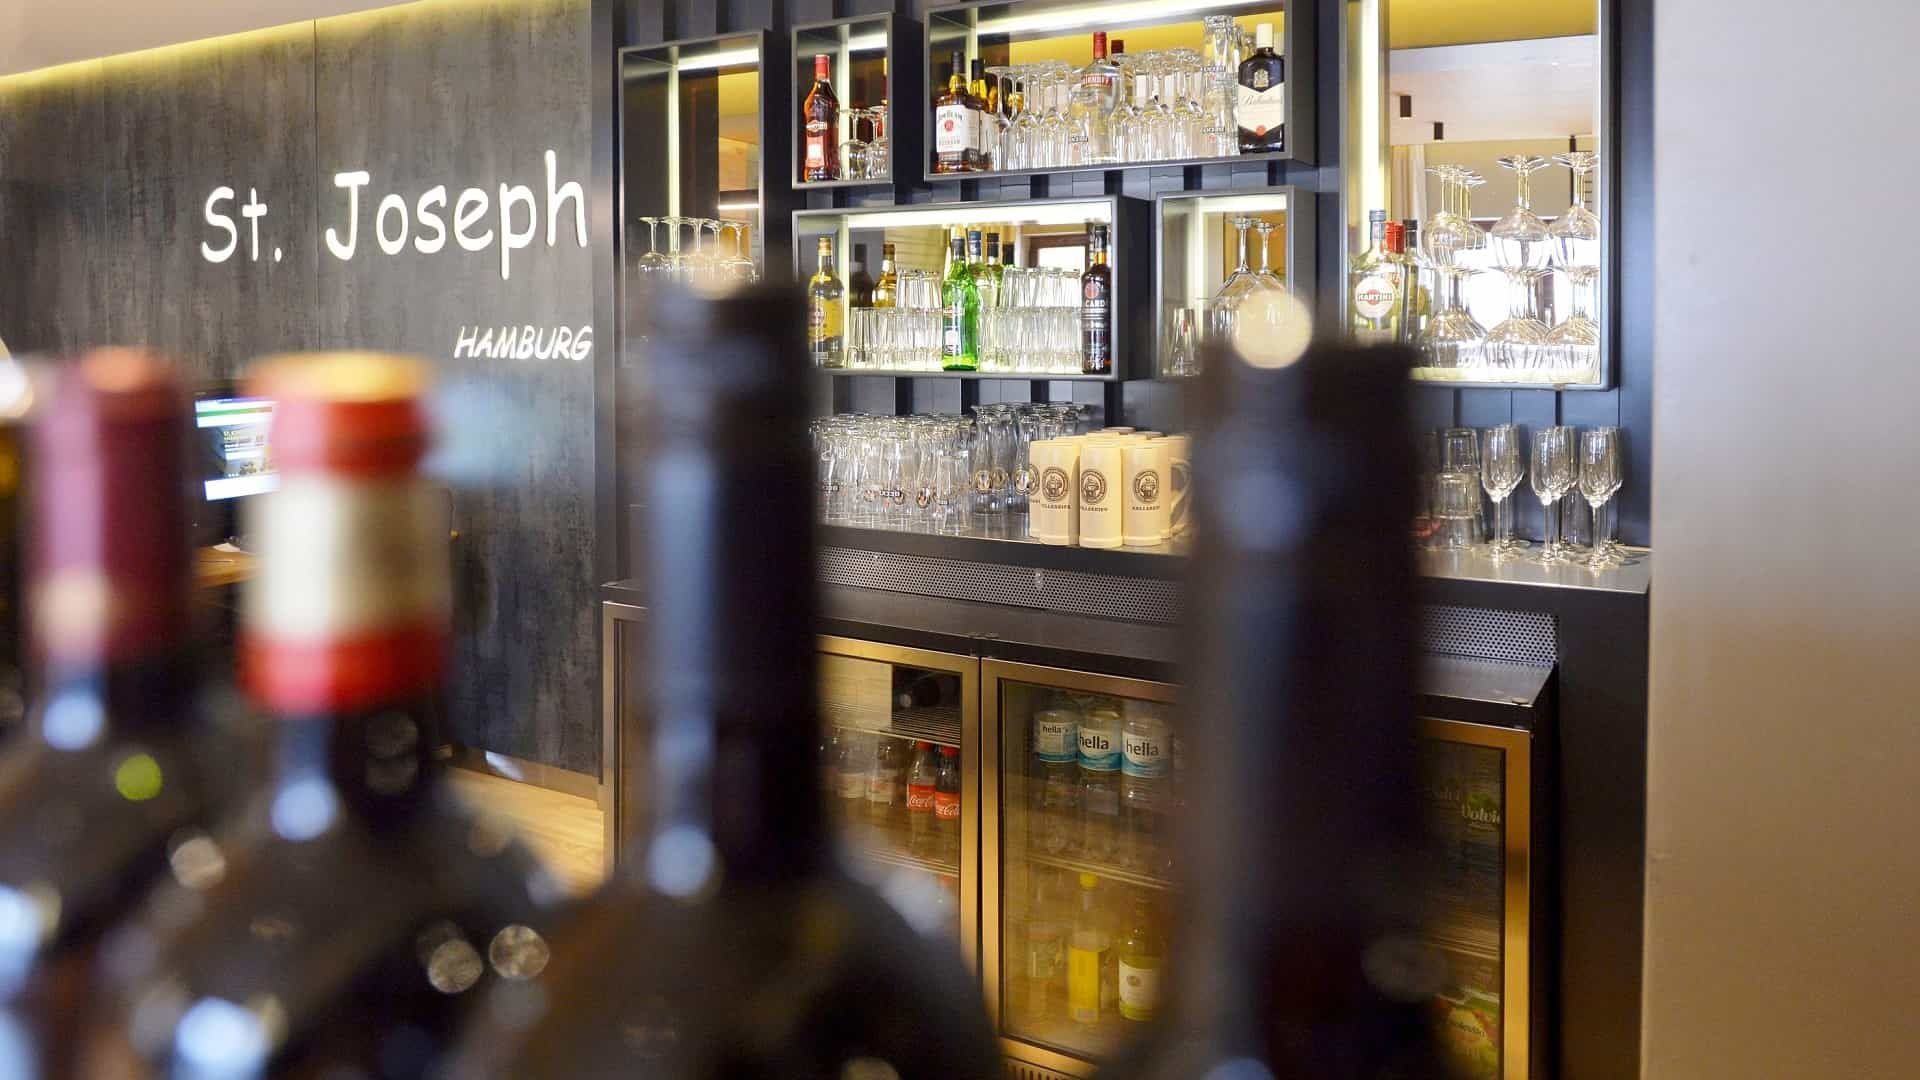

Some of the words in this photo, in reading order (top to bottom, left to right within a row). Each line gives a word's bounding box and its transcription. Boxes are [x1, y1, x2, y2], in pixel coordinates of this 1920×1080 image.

[201, 186, 282, 263] St.
[325, 149, 588, 280] Joseph
[454, 325, 593, 361] HAMBURG
[1126, 738, 1160, 756] hella
